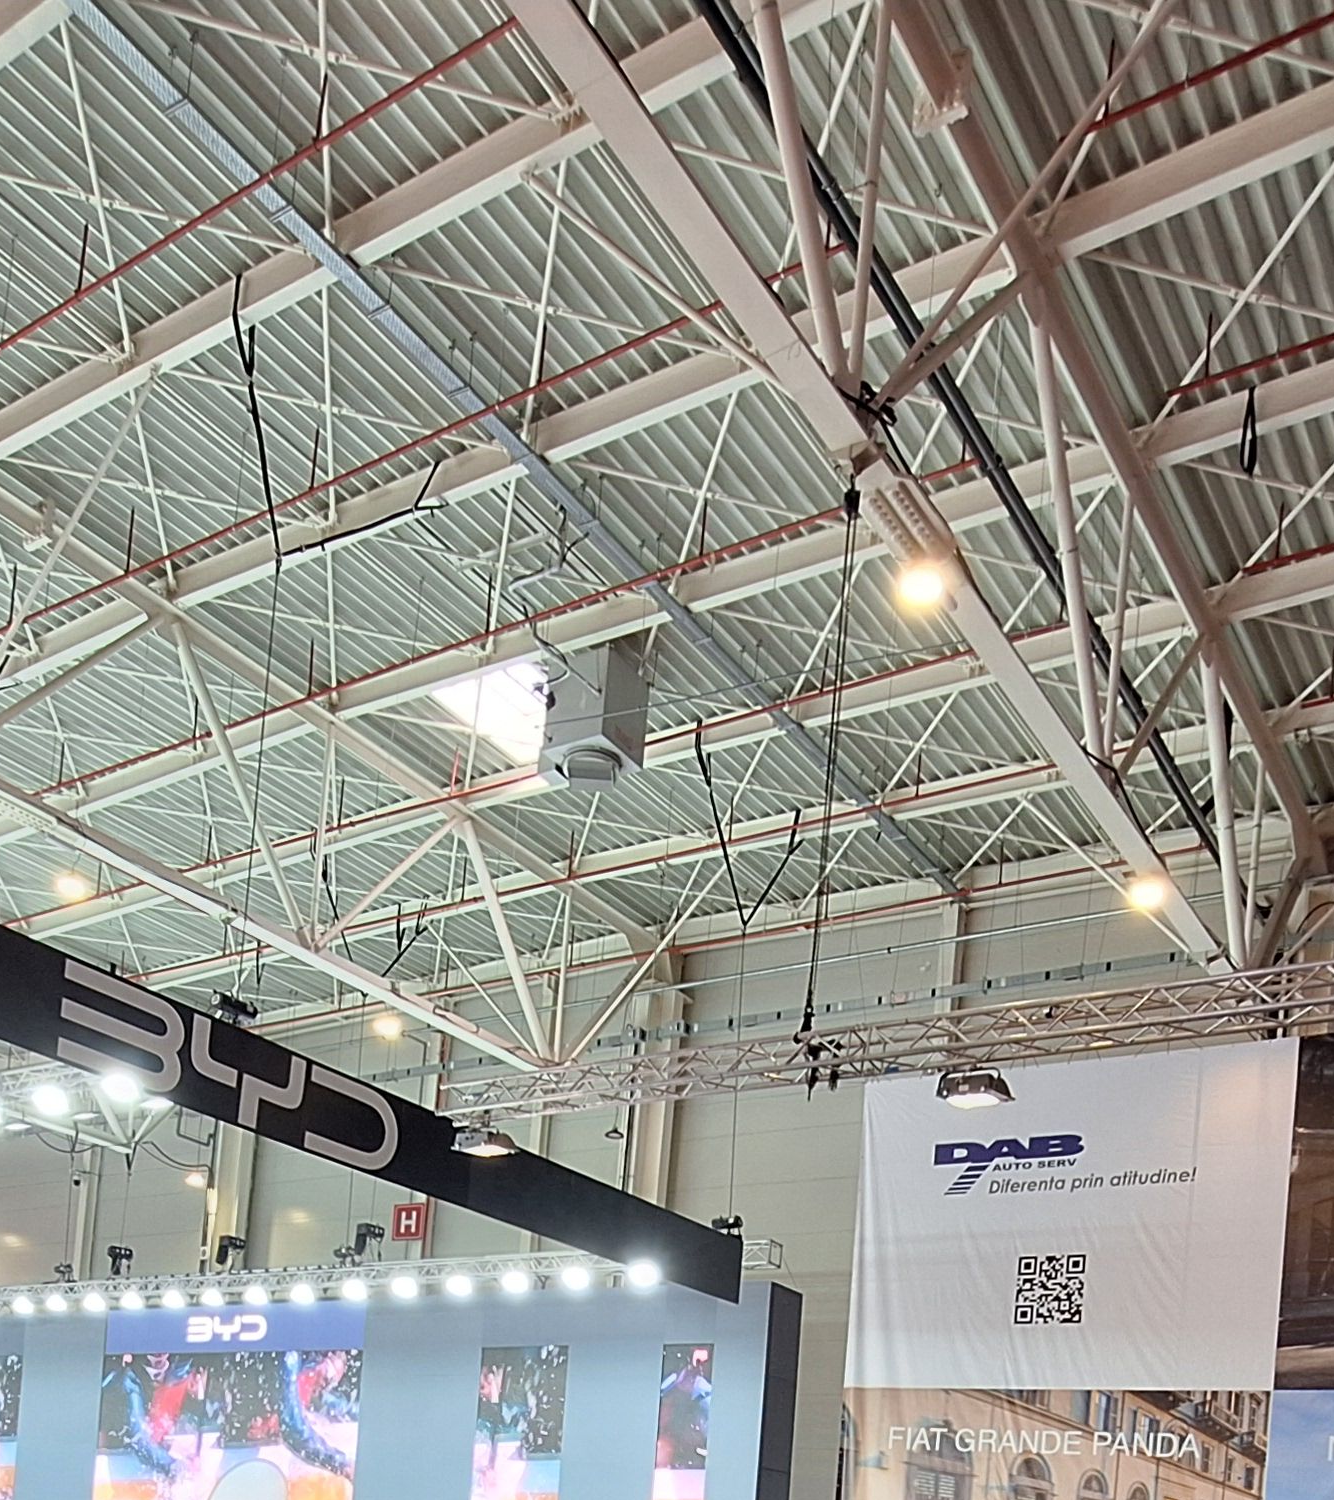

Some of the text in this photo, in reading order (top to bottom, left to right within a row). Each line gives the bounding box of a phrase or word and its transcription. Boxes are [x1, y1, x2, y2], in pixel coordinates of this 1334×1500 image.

[57, 957, 398, 1170] BYD
[933, 1133, 1085, 1166] DAB
[992, 1158, 1077, 1172] AUTO SERV
[988, 1167, 1197, 1195] Diferenta prin atitudine!
[400, 1211, 417, 1234] H
[186, 1314, 267, 1343] BYD
[887, 1426, 1202, 1460] FIAT GRANDE PANDA
